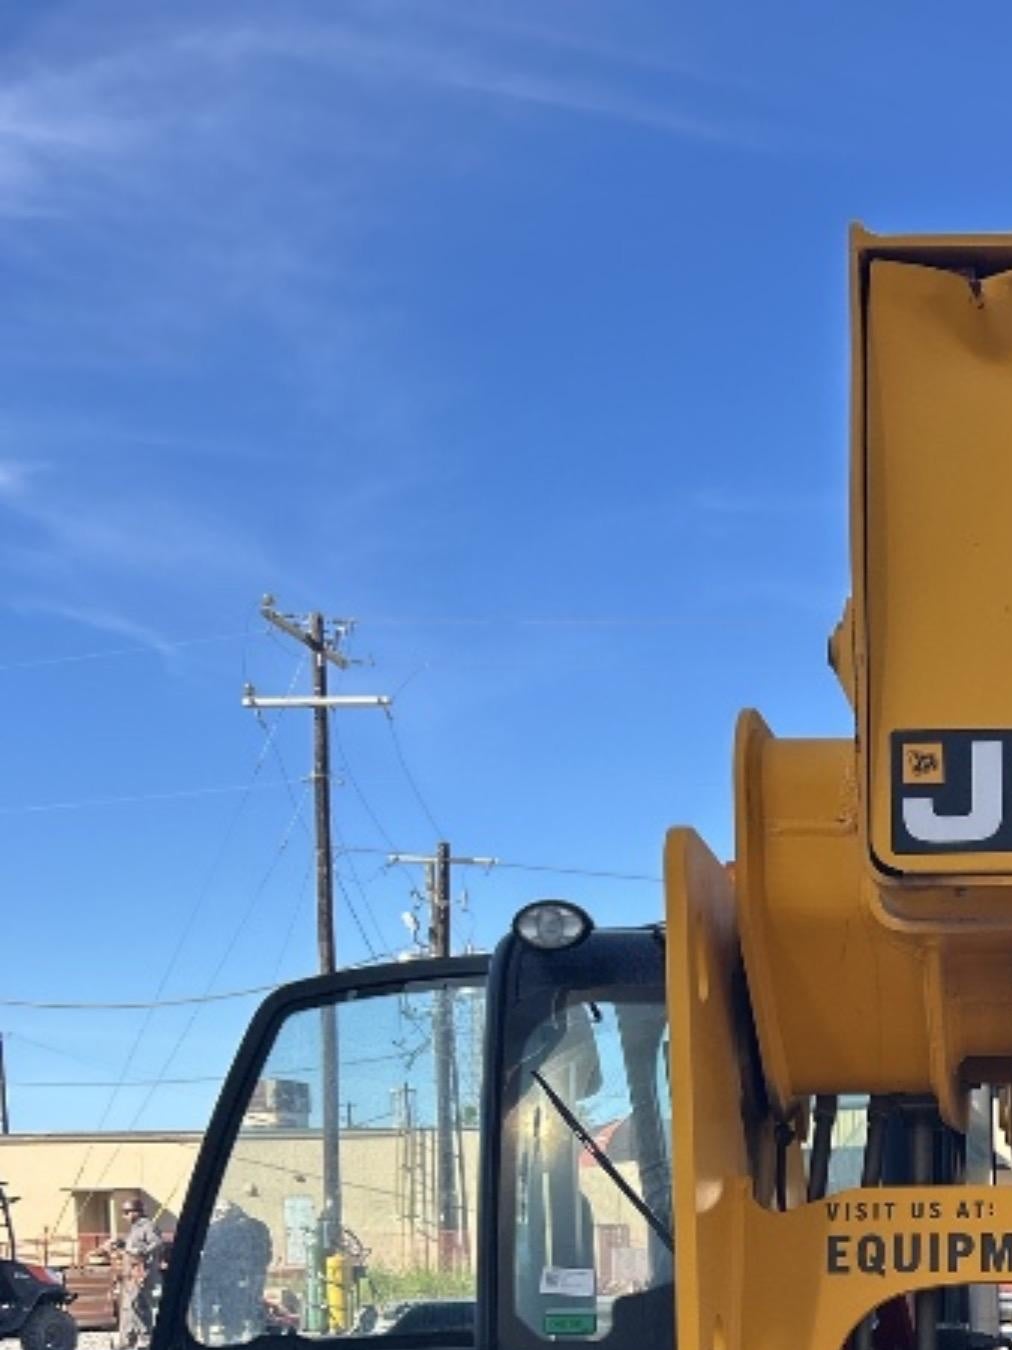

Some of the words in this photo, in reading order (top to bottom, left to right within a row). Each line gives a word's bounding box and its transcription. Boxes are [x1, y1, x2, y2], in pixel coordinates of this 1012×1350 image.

[826, 1202, 895, 1221] VISIT
[911, 1202, 941, 1219] US
[956, 1201, 995, 1219] AT:
